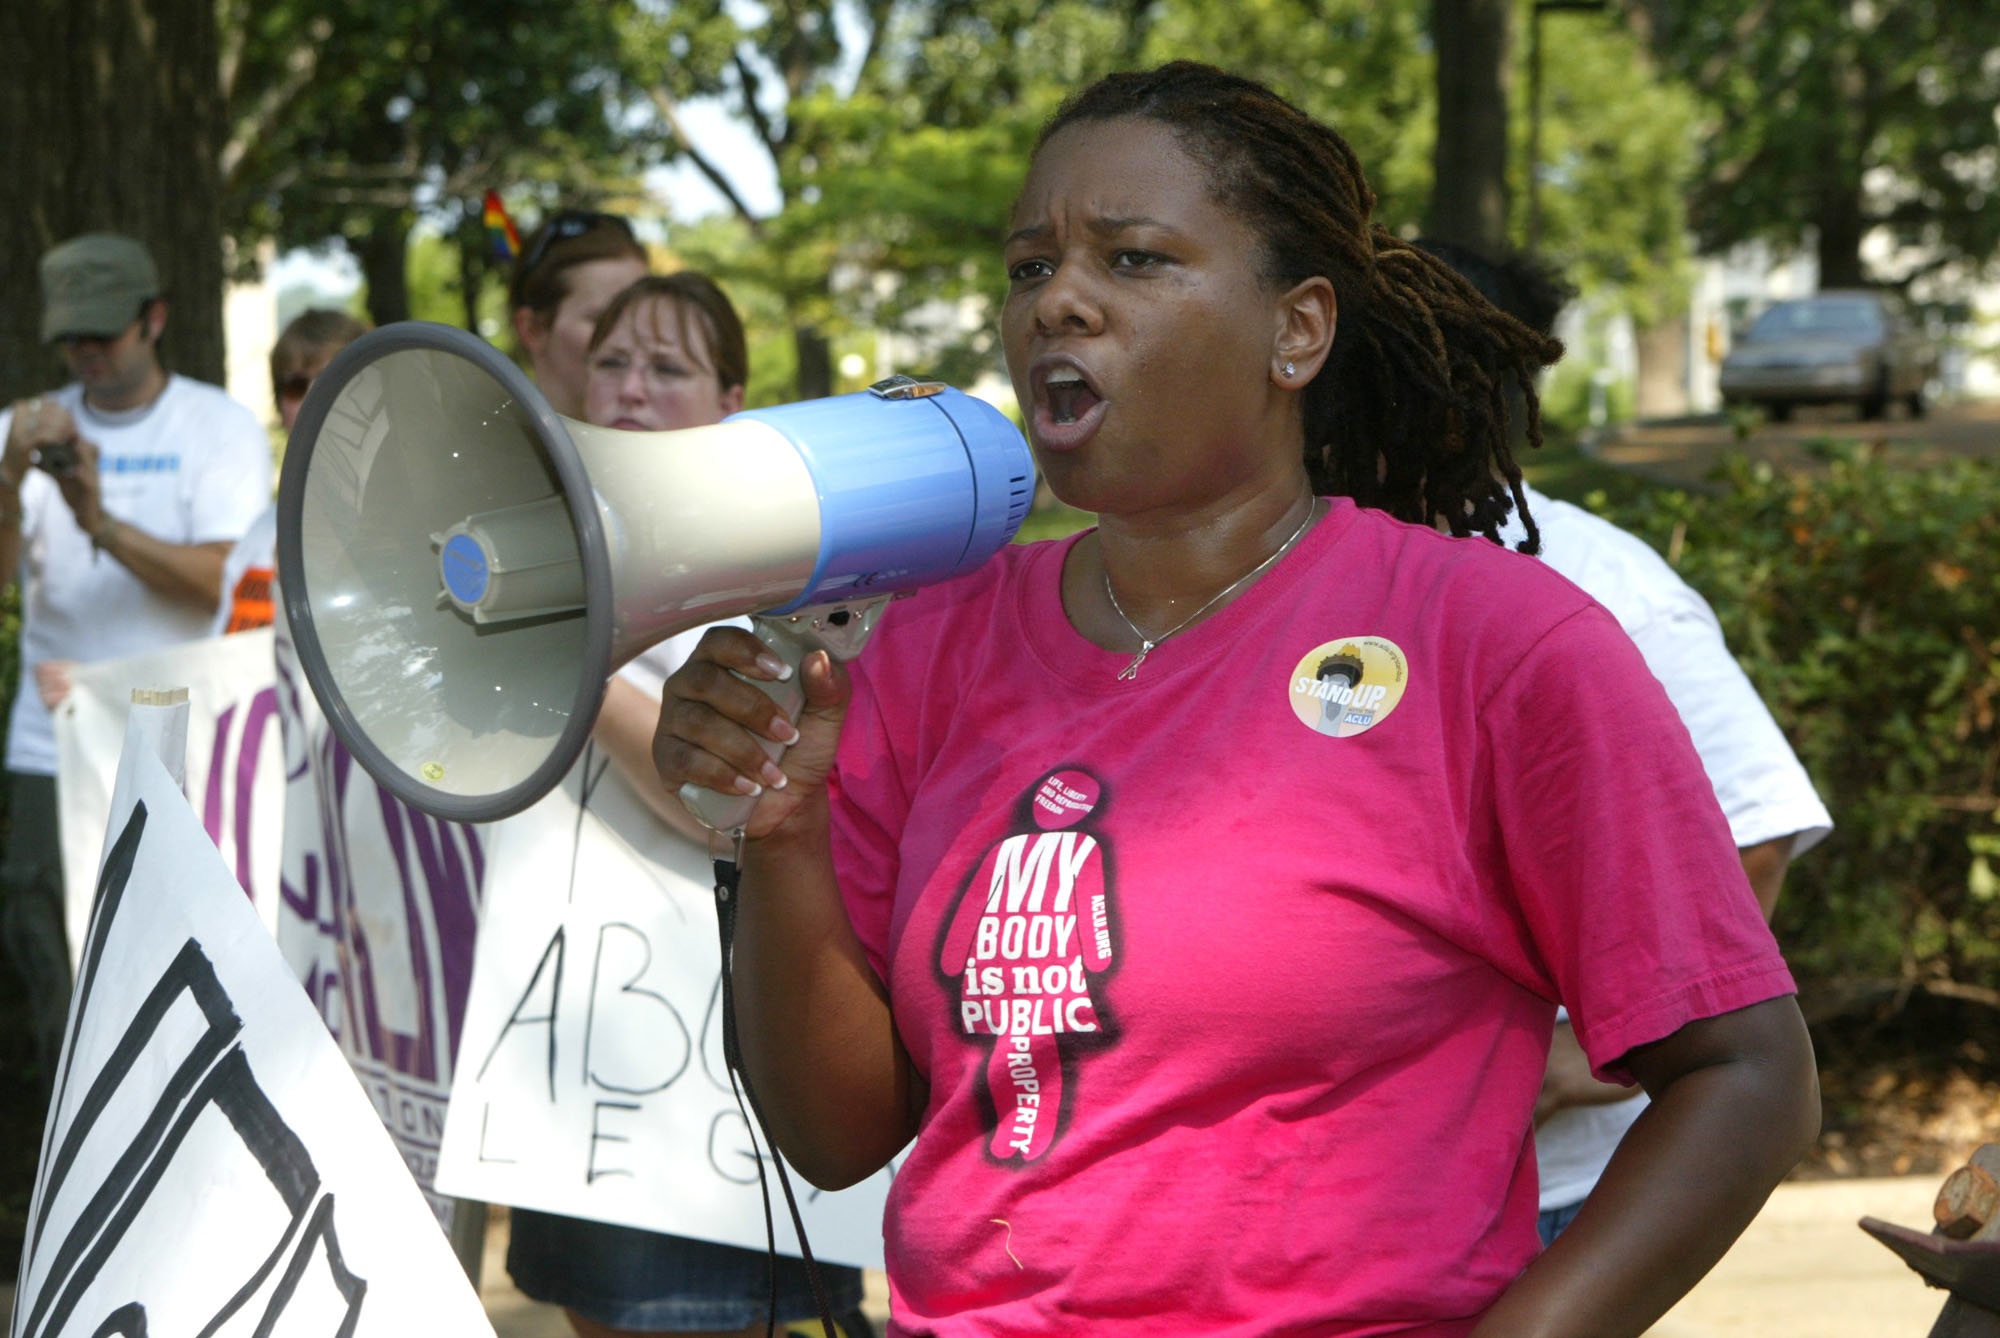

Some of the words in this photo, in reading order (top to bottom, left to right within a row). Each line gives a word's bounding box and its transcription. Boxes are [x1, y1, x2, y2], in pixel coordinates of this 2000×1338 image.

[1345, 715, 1371, 725] ACLU
[985, 832, 1097, 913] MY
[976, 915, 1077, 960] BODY
[1091, 894, 1113, 960] ACLU.ORG
[965, 957, 1005, 995] is
[1012, 955, 1088, 995] not
[961, 998, 1097, 1036] PUBLIC
[1007, 1036, 1040, 1154] PROPERTY
[479, 1100, 895, 1203] LEG
